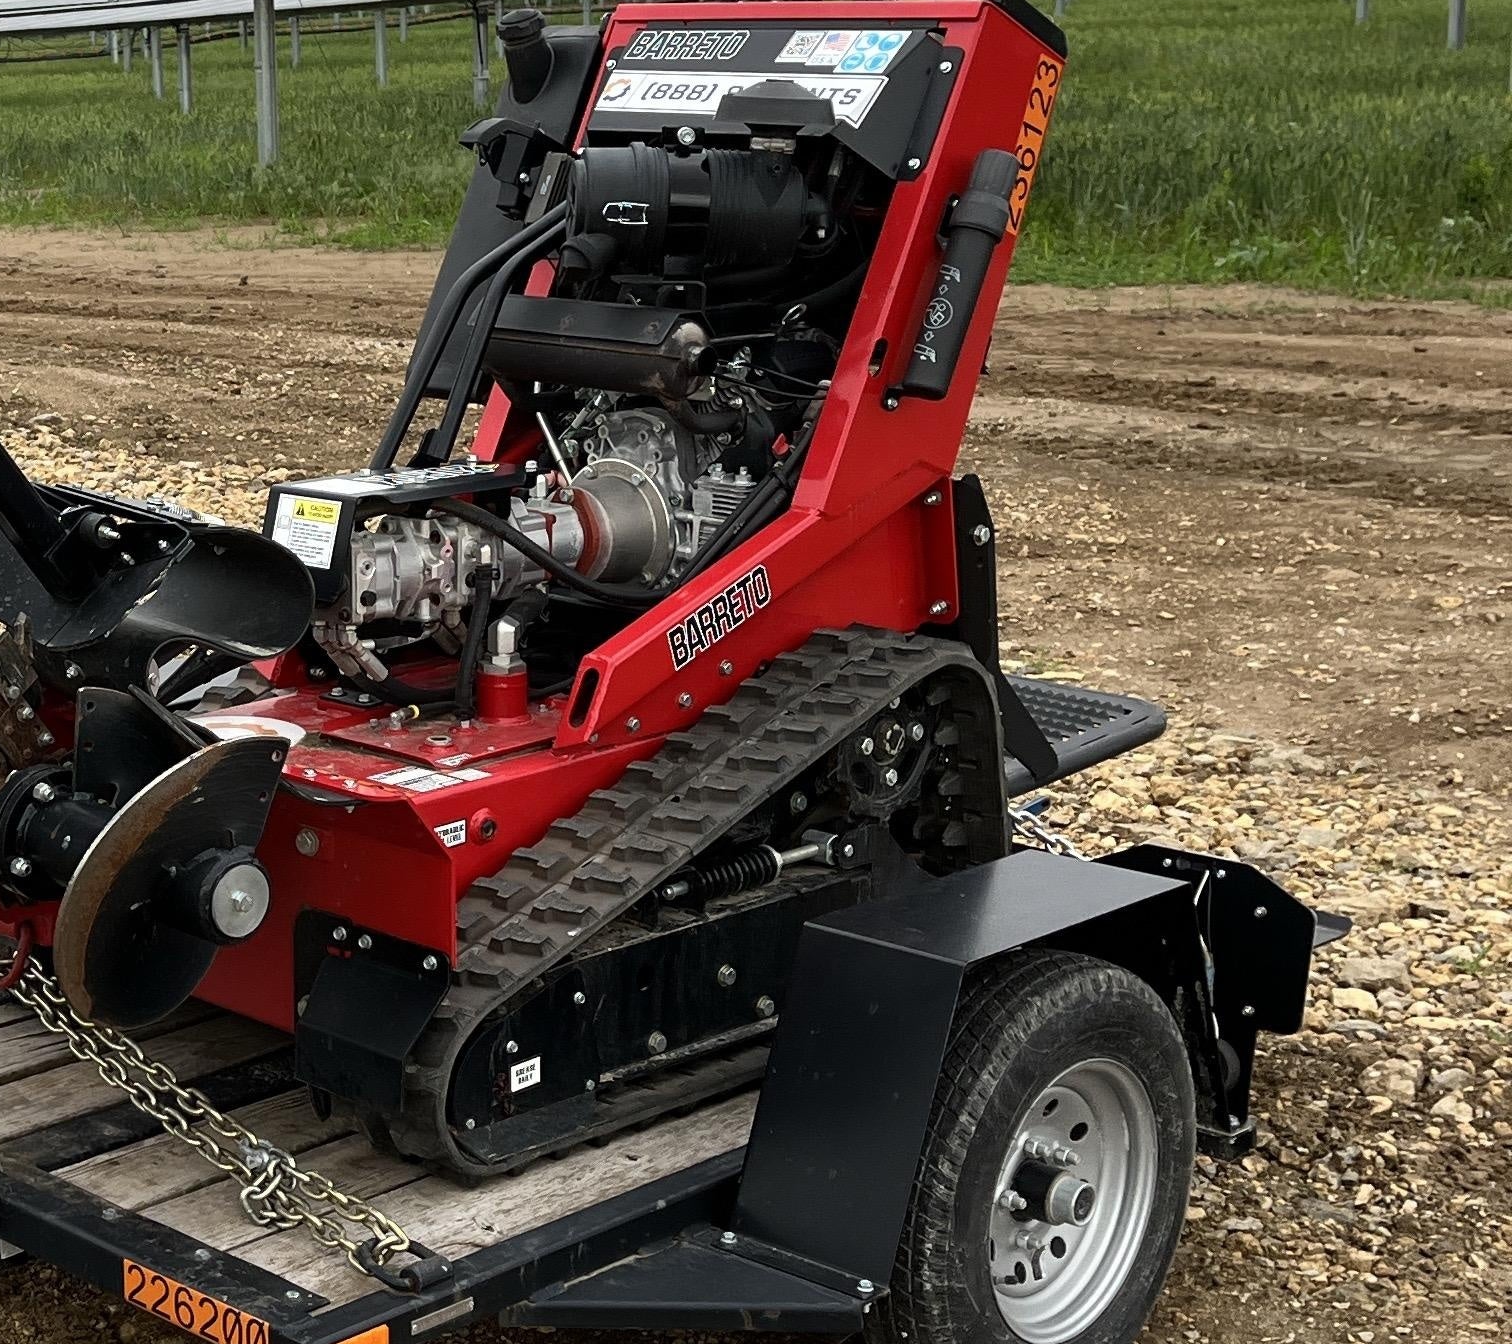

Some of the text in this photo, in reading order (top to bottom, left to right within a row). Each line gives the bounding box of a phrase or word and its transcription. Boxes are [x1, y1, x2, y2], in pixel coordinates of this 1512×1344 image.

[624, 30, 750, 60] BARRETO
[640, 82, 719, 103] (888)
[1008, 59, 1059, 231] 236123
[667, 564, 771, 671] BARRETO
